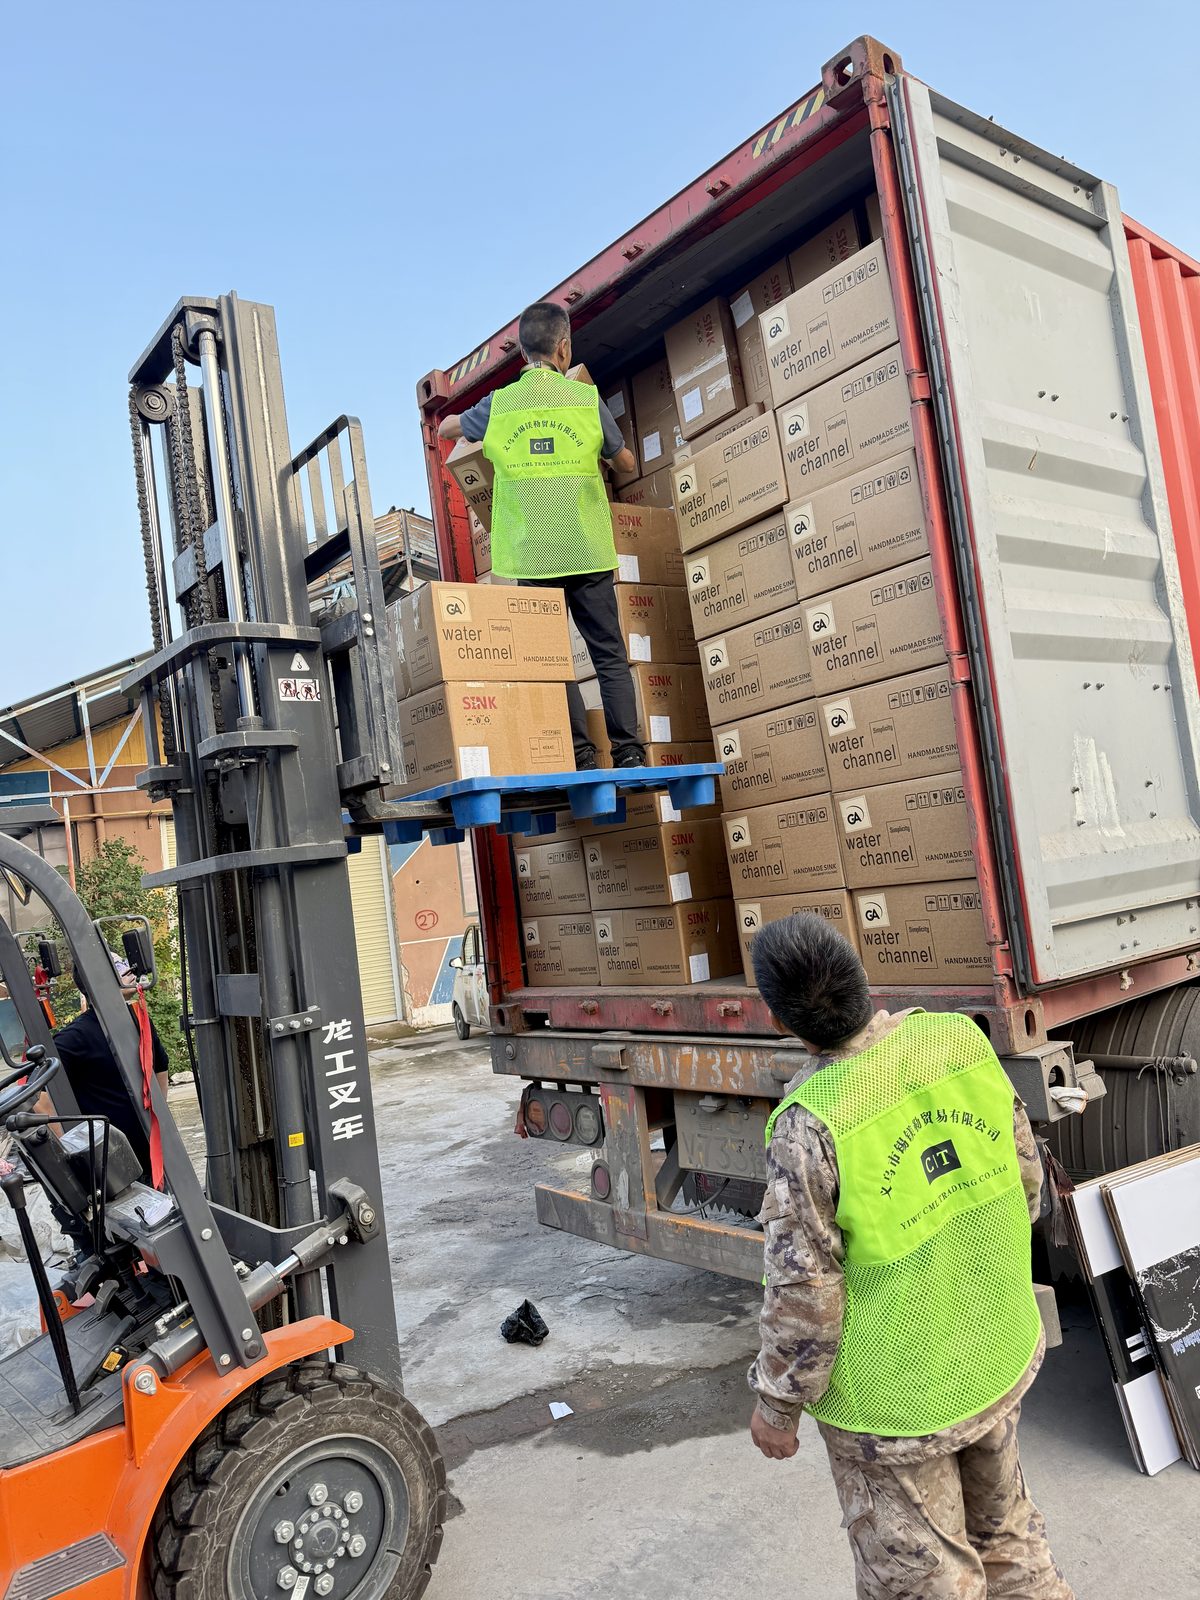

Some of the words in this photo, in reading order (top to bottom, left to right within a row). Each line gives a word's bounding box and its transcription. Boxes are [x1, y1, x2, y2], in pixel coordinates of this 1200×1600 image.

[770, 274, 782, 301] SIN
[704, 314, 715, 346] SINK
[770, 324, 783, 339] GA
[841, 326, 874, 350] HANDMADE
[874, 318, 889, 331] SINK
[770, 339, 802, 369] water
[783, 339, 830, 380] channel
[789, 422, 801, 436] GA
[860, 428, 893, 450] HANDMADE
[895, 421, 909, 434] SINK
[788, 436, 819, 464] water
[800, 438, 849, 476] channel
[464, 474, 479, 485] GA
[680, 481, 690, 493] GA
[470, 488, 493, 504] wate
[738, 486, 766, 505] HANDMADE
[766, 480, 778, 491] SINK
[680, 492, 706, 516] water
[690, 495, 730, 528] channel
[618, 515, 642, 527] SINK
[795, 522, 807, 535] GA
[795, 536, 827, 560] water
[869, 534, 905, 553] HANDMADE
[906, 528, 921, 540] SINK
[808, 540, 858, 573] channel
[693, 572, 704, 584] GA
[693, 584, 720, 605] water
[754, 584, 783, 600] HANDMADE
[447, 604, 462, 615] GA
[629, 596, 654, 607] SINK
[704, 588, 745, 618] channel
[814, 619, 827, 632] GA
[444, 626, 482, 642] water
[458, 644, 512, 660] channel
[813, 635, 846, 657] water
[890, 639, 927, 655] HANDMADE
[928, 634, 944, 645] SINK
[573, 648, 588, 664] nnel
[711, 655, 721, 666] GA
[826, 641, 878, 672] channel
[649, 676, 672, 686] SINK
[708, 672, 735, 691] water
[770, 676, 798, 690] HANDMADE
[799, 672, 812, 681] SINK
[719, 677, 760, 705] channel
[463, 696, 497, 710] SINK
[832, 715, 845, 728] GA
[724, 744, 734, 755] GA
[829, 736, 864, 755] water
[908, 746, 944, 759] HANDMADE
[945, 744, 958, 753] SIN
[661, 754, 684, 766] SINK
[843, 744, 896, 771] channel
[732, 768, 772, 791] channel
[782, 770, 812, 782] HANDMADE
[812, 767, 825, 775] SINK
[848, 813, 862, 825] GA
[671, 833, 695, 846] SINK
[733, 832, 743, 842] GA
[846, 834, 880, 851] water
[731, 850, 758, 865] water
[860, 845, 914, 868] channel
[925, 851, 962, 861] HANDMADE
[590, 869, 609, 881] water
[742, 860, 783, 880] channel
[793, 865, 824, 874] HANDMADE
[598, 879, 628, 894] channel
[526, 888, 552, 902] channel
[418, 913, 436, 926] 27
[687, 912, 710, 925] SINK
[744, 916, 758, 928] GA
[866, 909, 880, 921] GA
[864, 930, 899, 946] water
[527, 948, 545, 960] water
[599, 945, 620, 957] water
[878, 946, 933, 964] channel
[534, 960, 562, 972] channel
[607, 957, 639, 971] channel
[322, 1018, 364, 1140] 龙工叉车
[937, 1179, 977, 1202] TRADING
